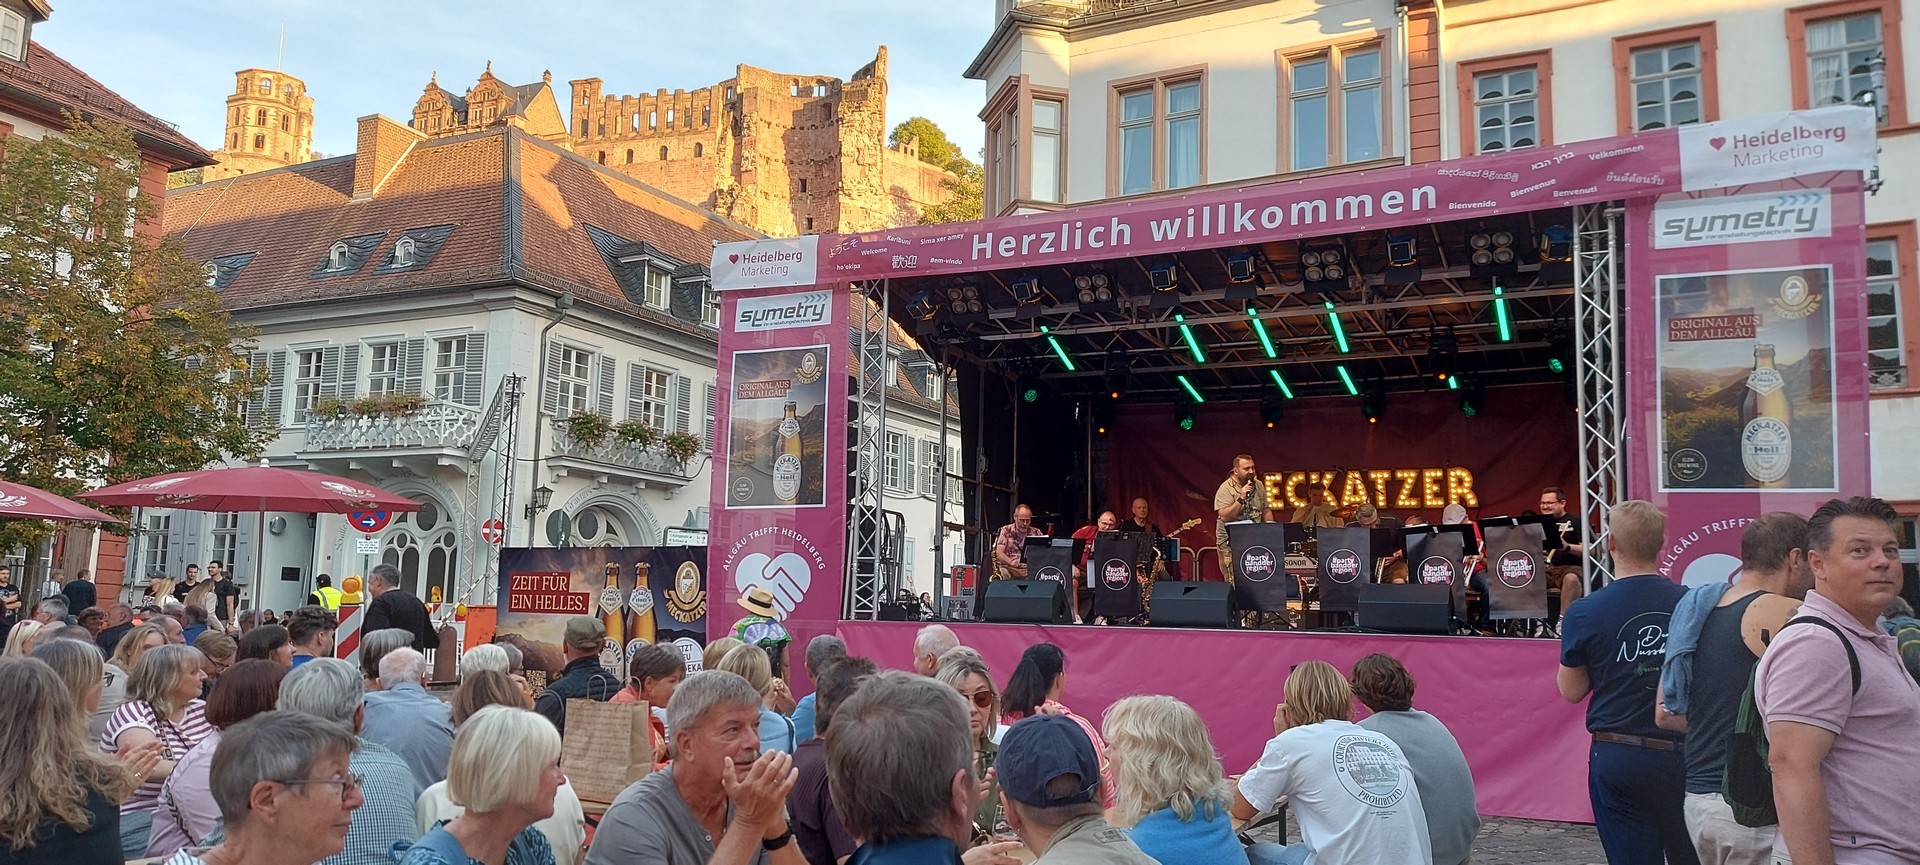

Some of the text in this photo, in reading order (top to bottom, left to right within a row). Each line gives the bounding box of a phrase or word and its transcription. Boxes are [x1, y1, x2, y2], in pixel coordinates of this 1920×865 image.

[1733, 125, 1846, 150] Heidelberg
[1588, 144, 1644, 161] Velkommen
[1733, 143, 1824, 168] Marketing
[1510, 178, 1556, 198] Bienvenue
[1553, 186, 1598, 198] Benvenuti
[1448, 200, 1497, 210] Bienvenido
[971, 183, 1437, 260] Herzlich willkommen
[1662, 205, 1818, 241] symetry
[829, 238, 859, 258] ようこそ
[861, 247, 888, 256] Welcome
[742, 251, 803, 265] Heidelberg
[930, 257, 963, 265] Bem-vindo
[741, 264, 789, 277] Marketing
[740, 302, 825, 327] symetry
[1670, 315, 1760, 329] ORIGINAL AUS
[1671, 326, 1754, 340] DEM ALLGÄU.
[739, 380, 790, 391] ORIGINAL AUS
[738, 391, 755, 399] DEM
[1745, 421, 1787, 442] MECKATZER
[1262, 467, 1479, 510] ECKATZER
[722, 526, 826, 571] ALLGÄU TRIFFT HEIDELBERG
[1658, 531, 1700, 576] ALLGÄU
[512, 573, 568, 591] ZEIT FÜR
[511, 595, 586, 611] EIN HELLES.
[603, 641, 621, 663] ATZER
[680, 644, 693, 652] TZT
[683, 653, 691, 661] EU
[688, 664, 702, 672] EKA
[1358, 788, 1403, 806] PROHIBITED
